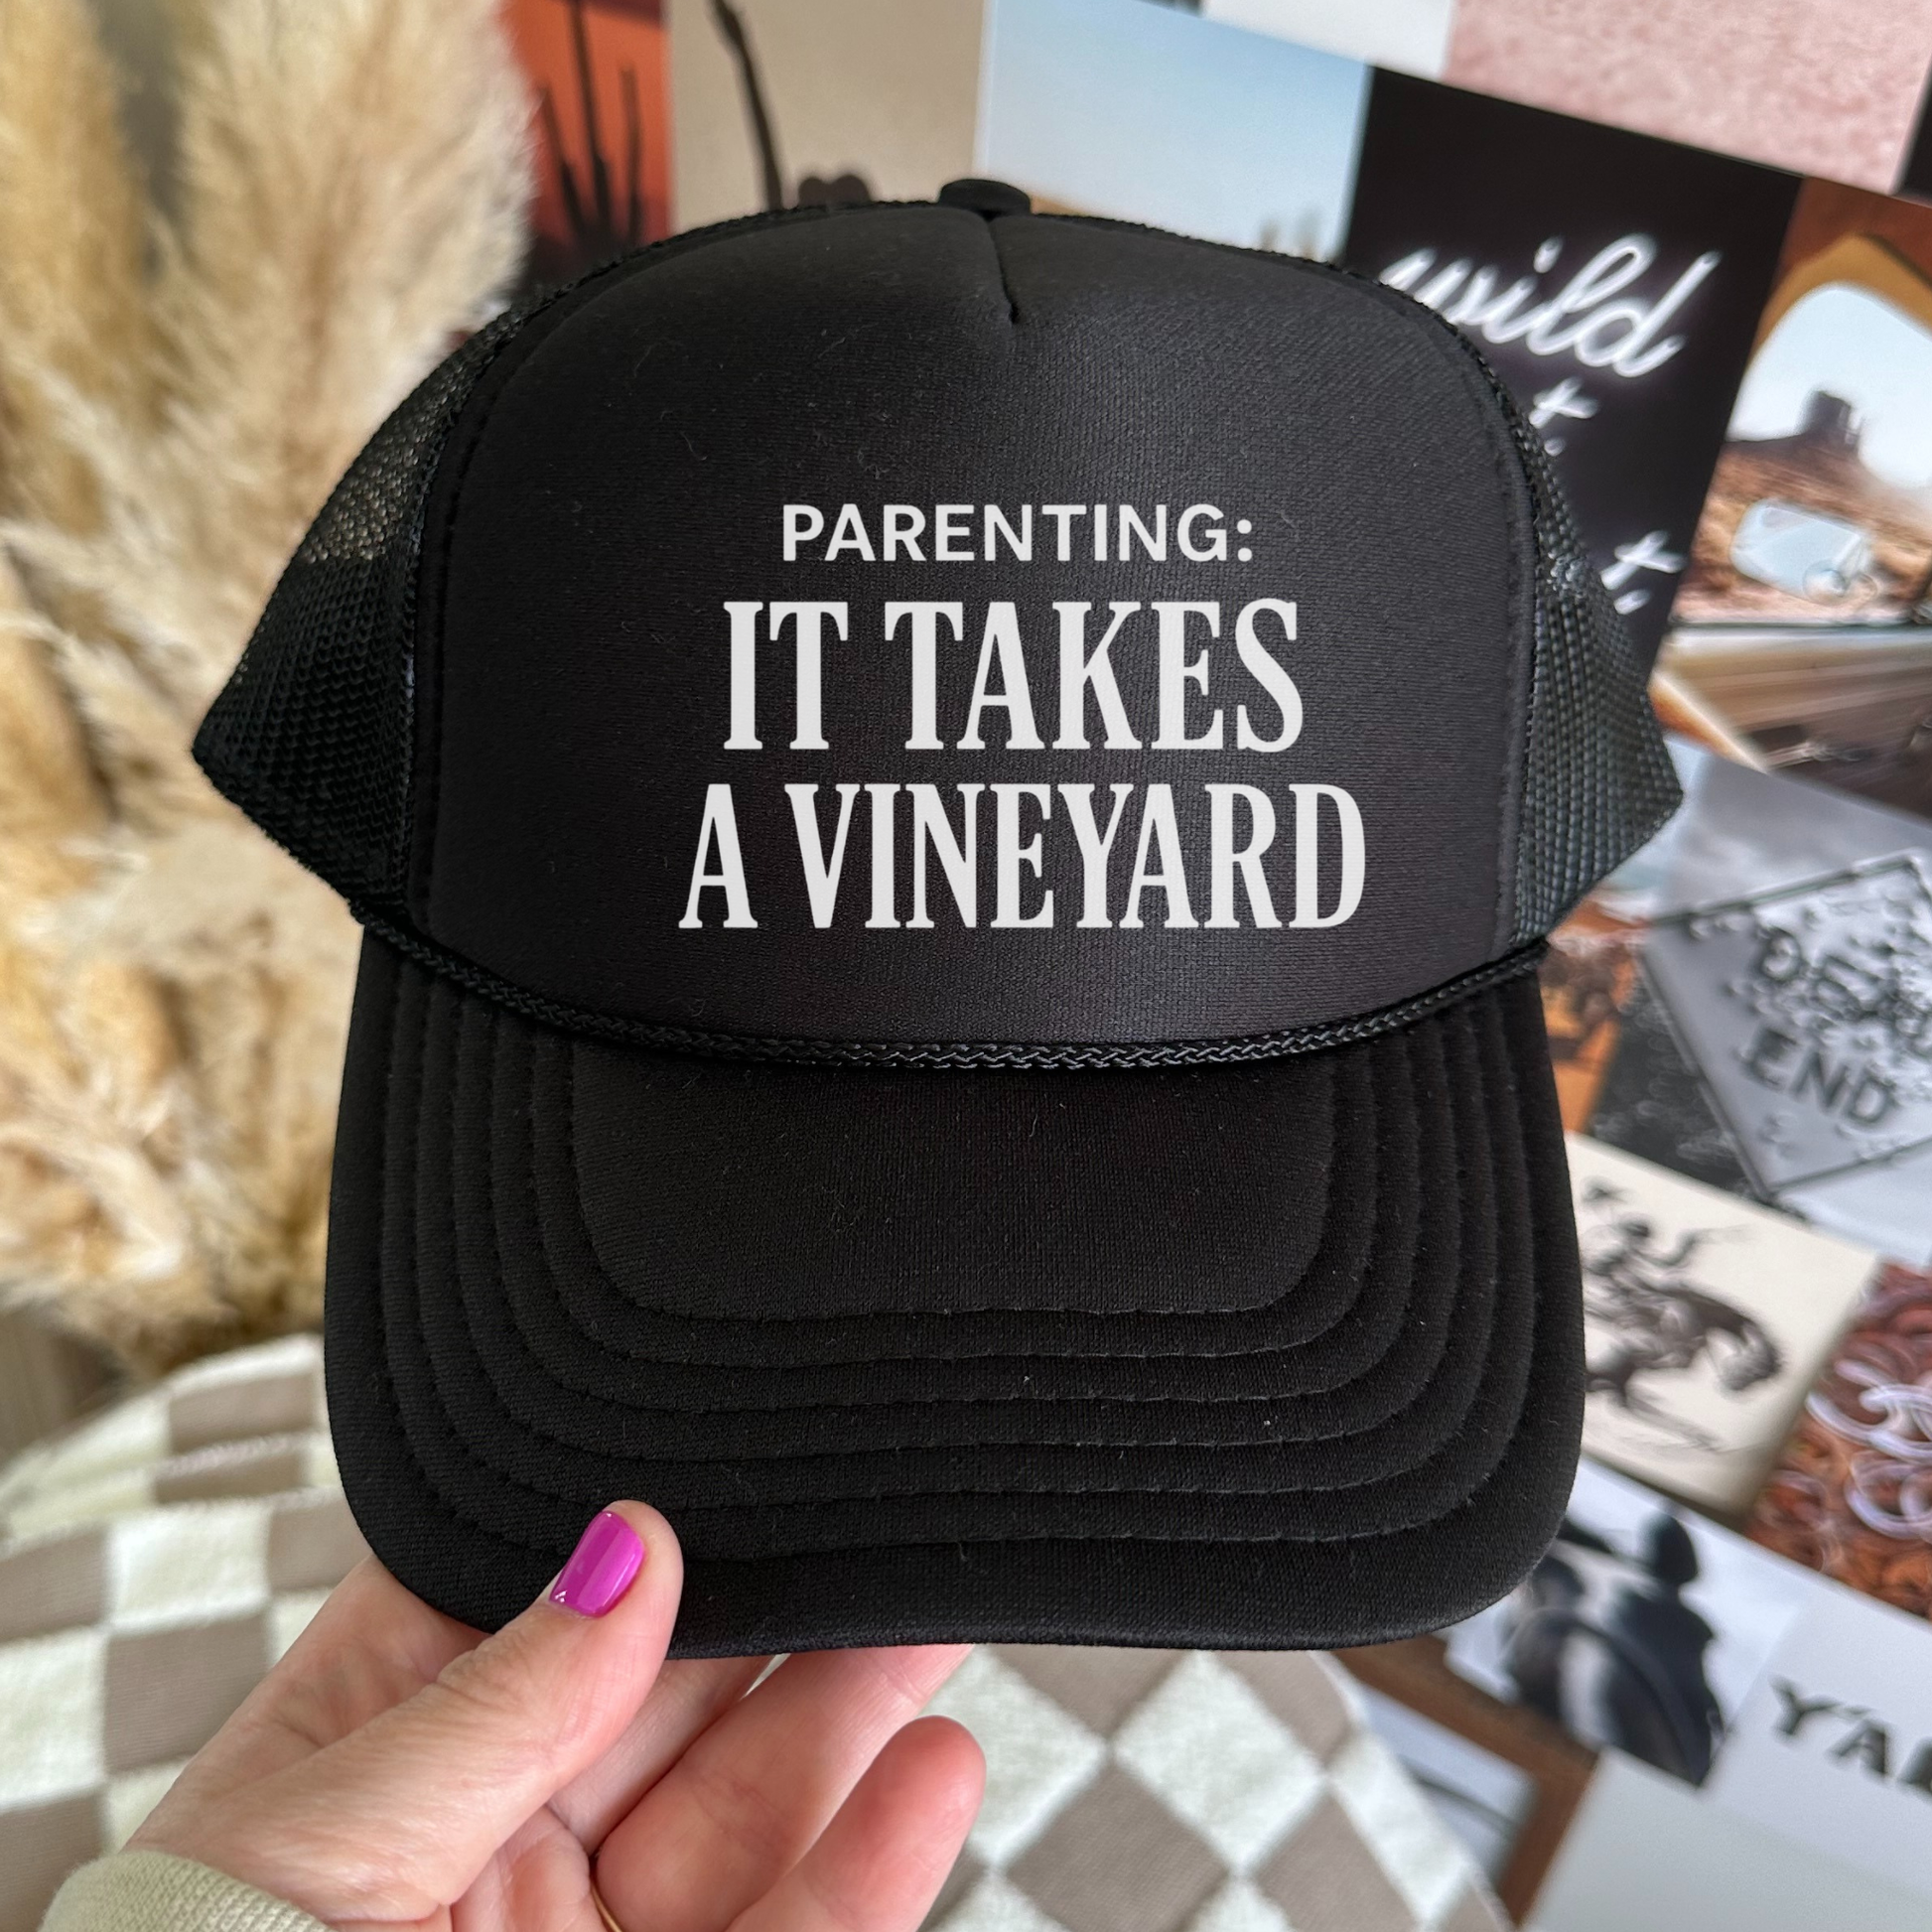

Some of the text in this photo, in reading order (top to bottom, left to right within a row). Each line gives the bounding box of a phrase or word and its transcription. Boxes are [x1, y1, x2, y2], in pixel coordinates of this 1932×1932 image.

[782, 503, 1253, 563] PARENTING:
[723, 598, 1304, 753] IT TAKES
[678, 783, 1366, 929] A VINEYARD
